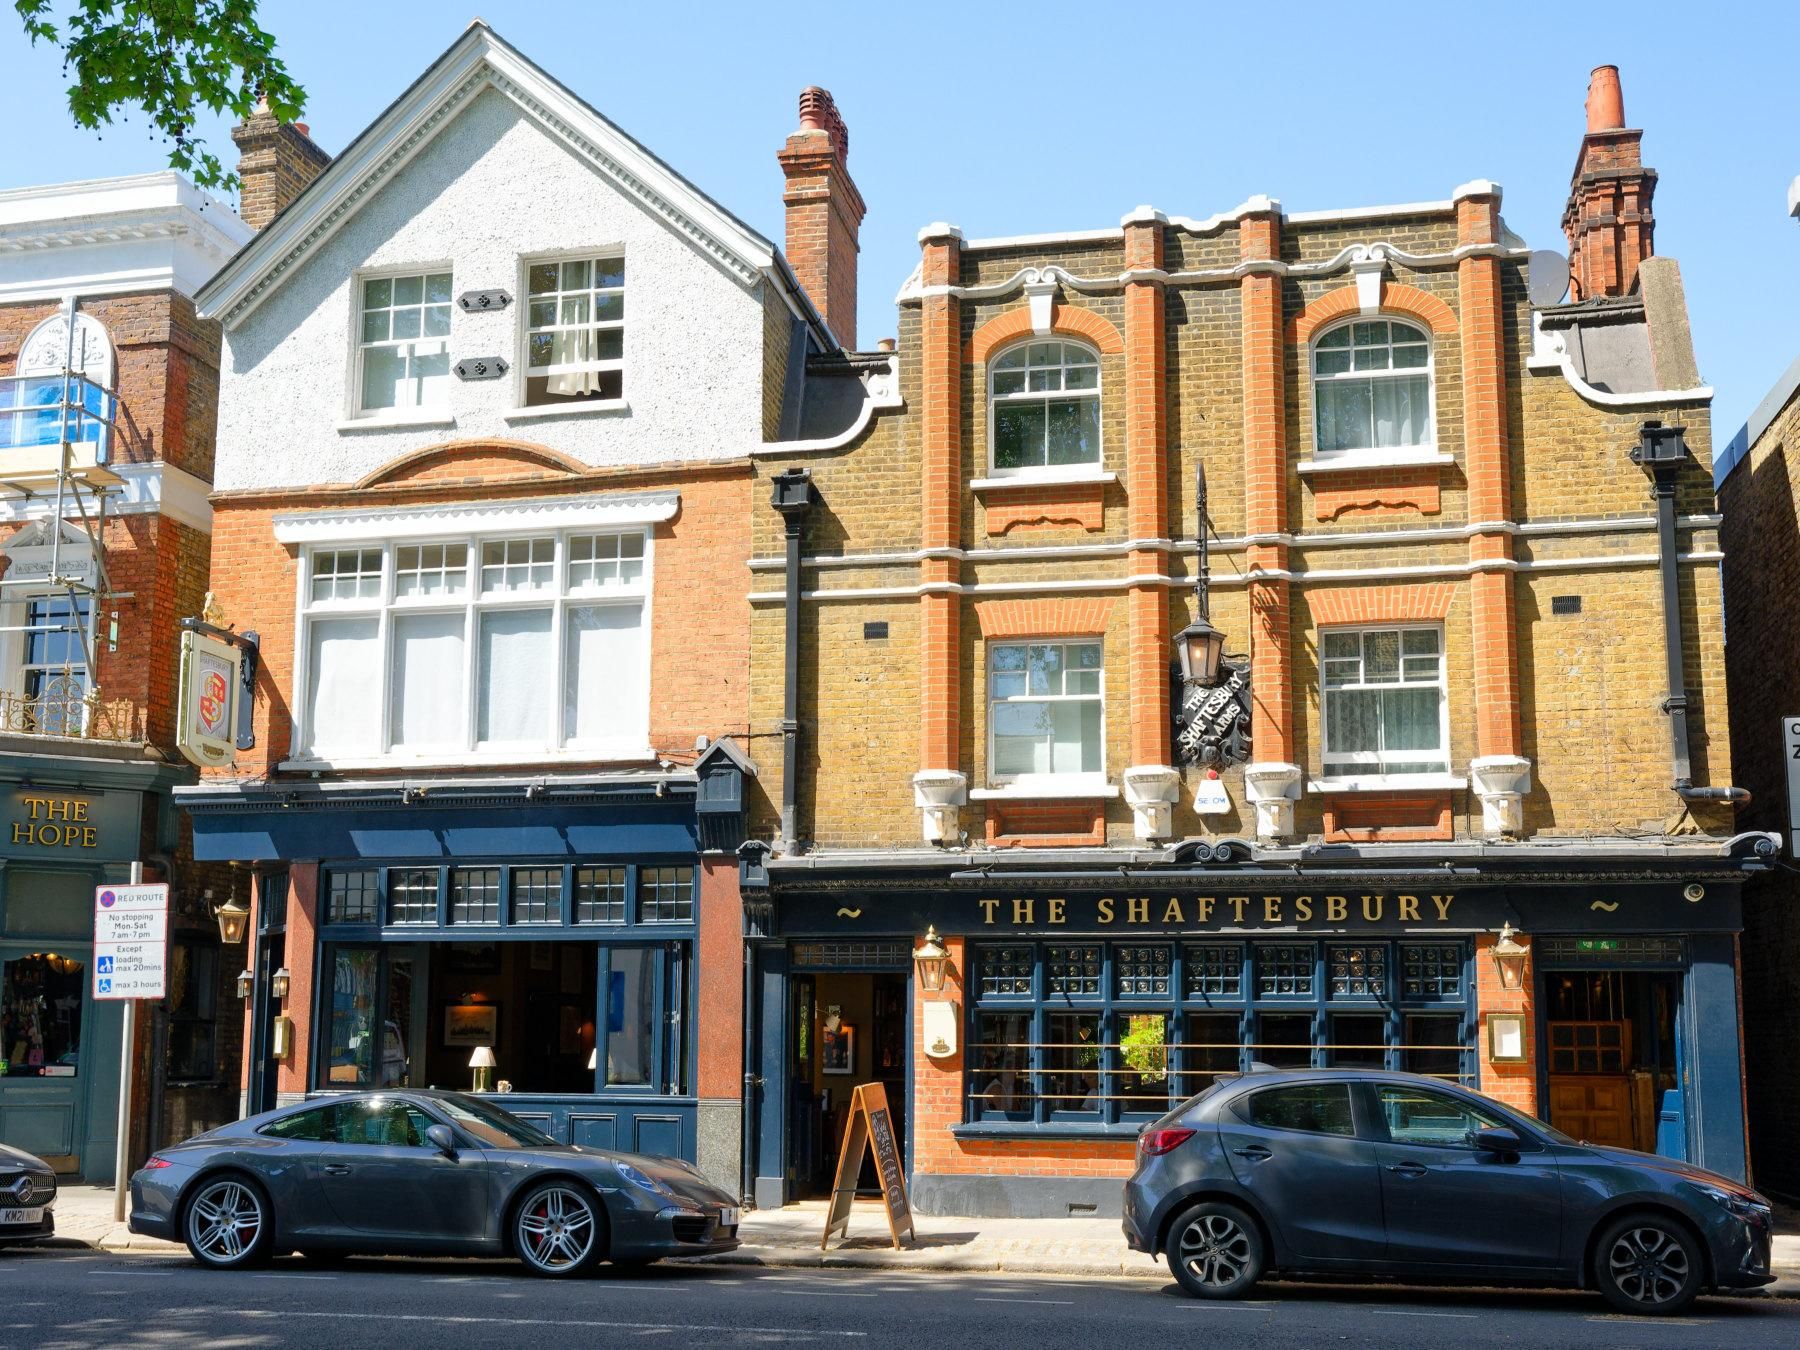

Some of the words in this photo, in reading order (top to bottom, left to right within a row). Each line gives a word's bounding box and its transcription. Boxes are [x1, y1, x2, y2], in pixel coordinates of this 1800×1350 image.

[1178, 671, 1243, 750] SHAFTESBURY
[1185, 689, 1210, 712] THE
[1213, 703, 1241, 736] ARMS
[24, 798, 88, 821] THE
[12, 822, 97, 847] HOPE
[118, 894, 135, 902] RED
[136, 893, 164, 902] ROUTE
[121, 913, 154, 921] stopping
[979, 898, 1066, 924] THE
[1097, 895, 1454, 923] SHAFTESBURY
[116, 956, 143, 964] loading
[117, 945, 142, 954] Except
[140, 980, 162, 988] hours
